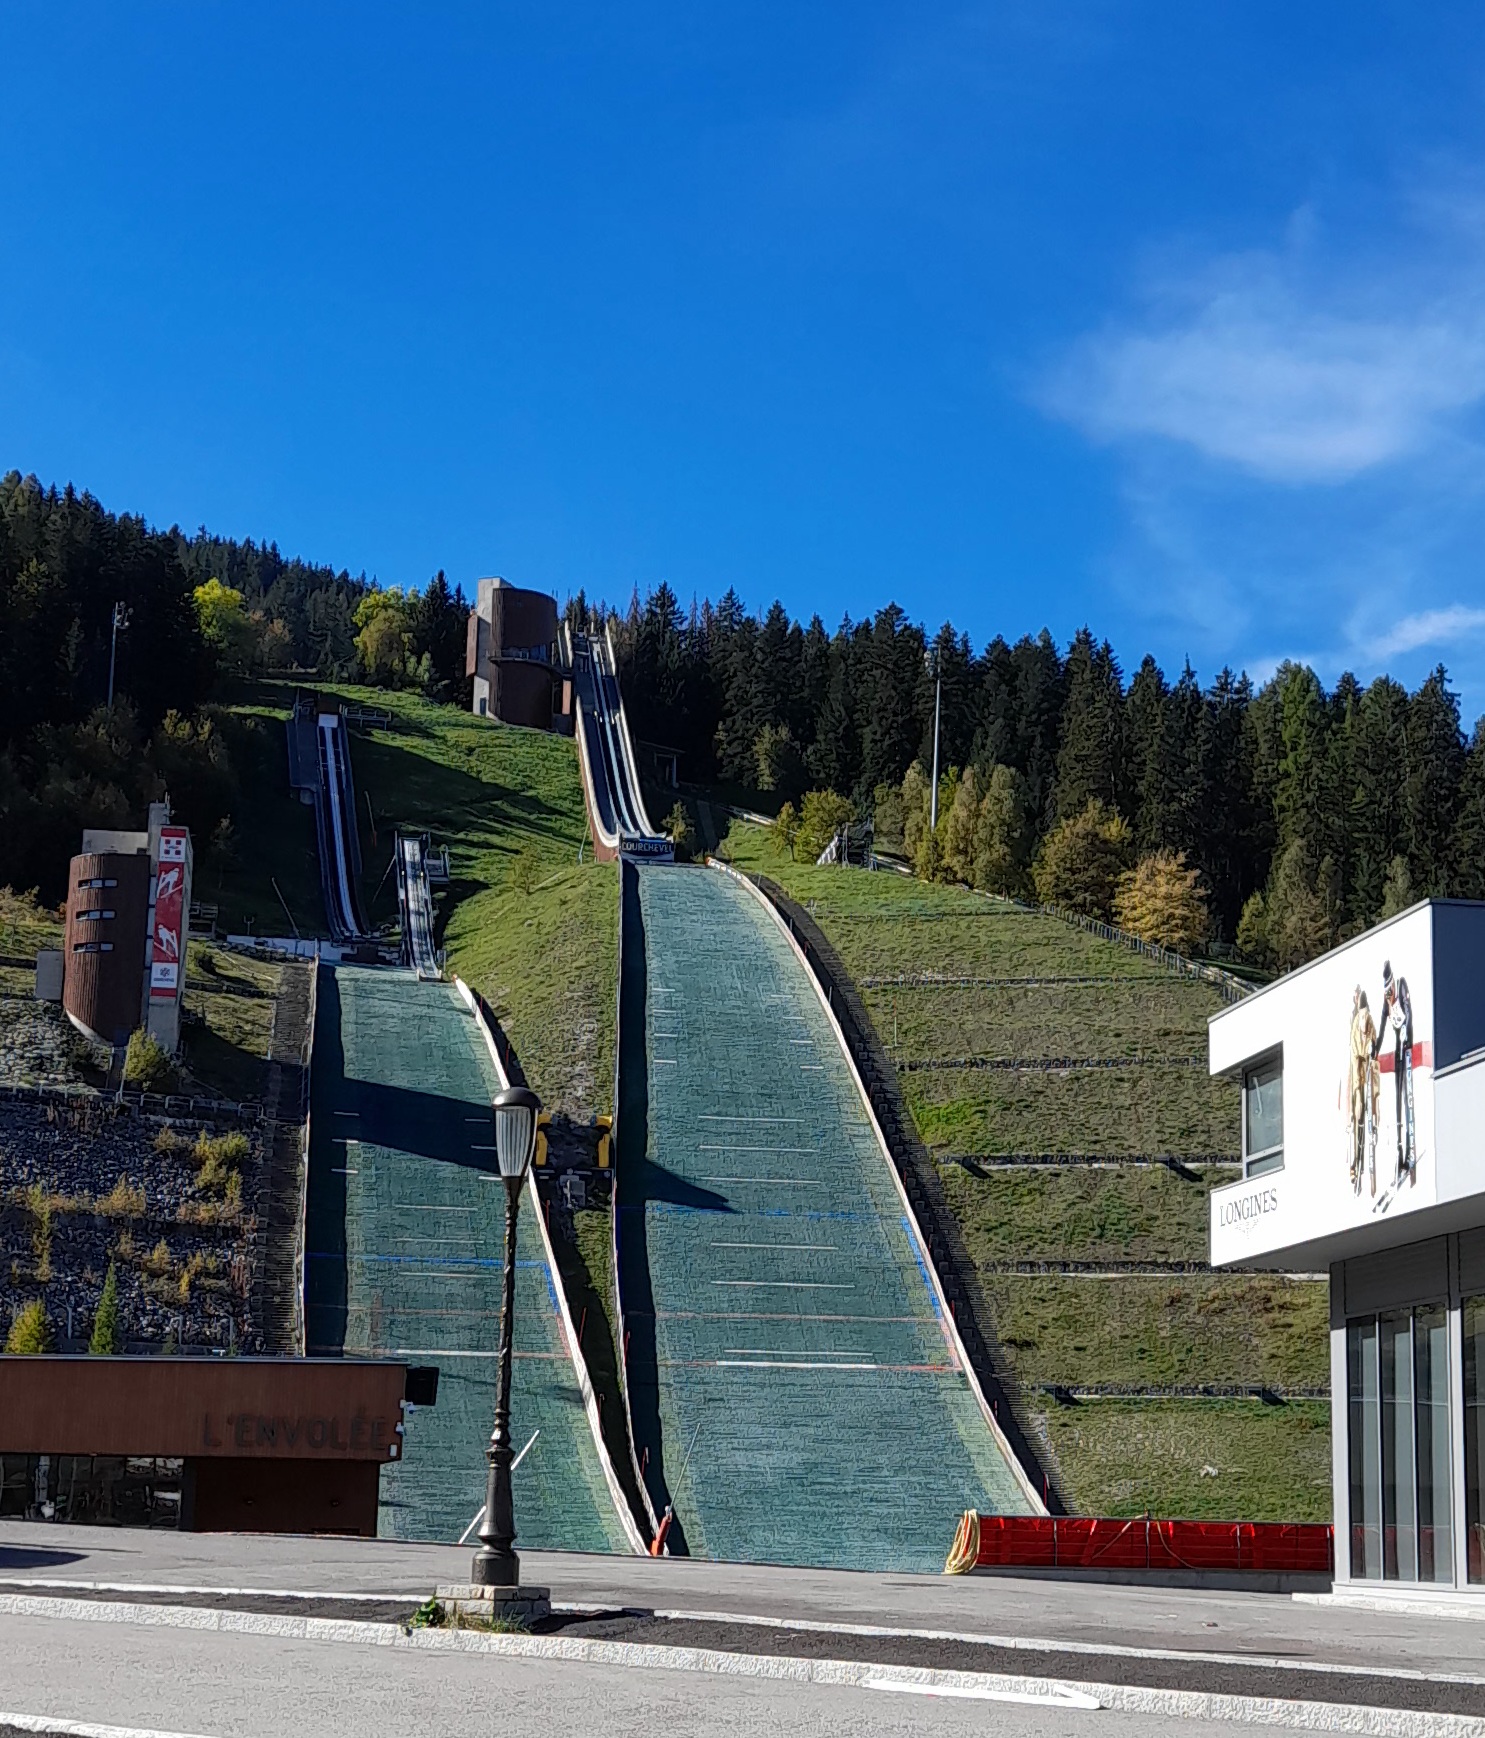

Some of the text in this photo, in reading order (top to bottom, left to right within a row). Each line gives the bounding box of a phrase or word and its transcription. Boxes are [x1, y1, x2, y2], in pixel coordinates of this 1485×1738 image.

[621, 842, 672, 853] COURCHEVEL
[1220, 1187, 1278, 1227] LONGINES
[203, 1406, 387, 1451] L'ENVOLÉE
